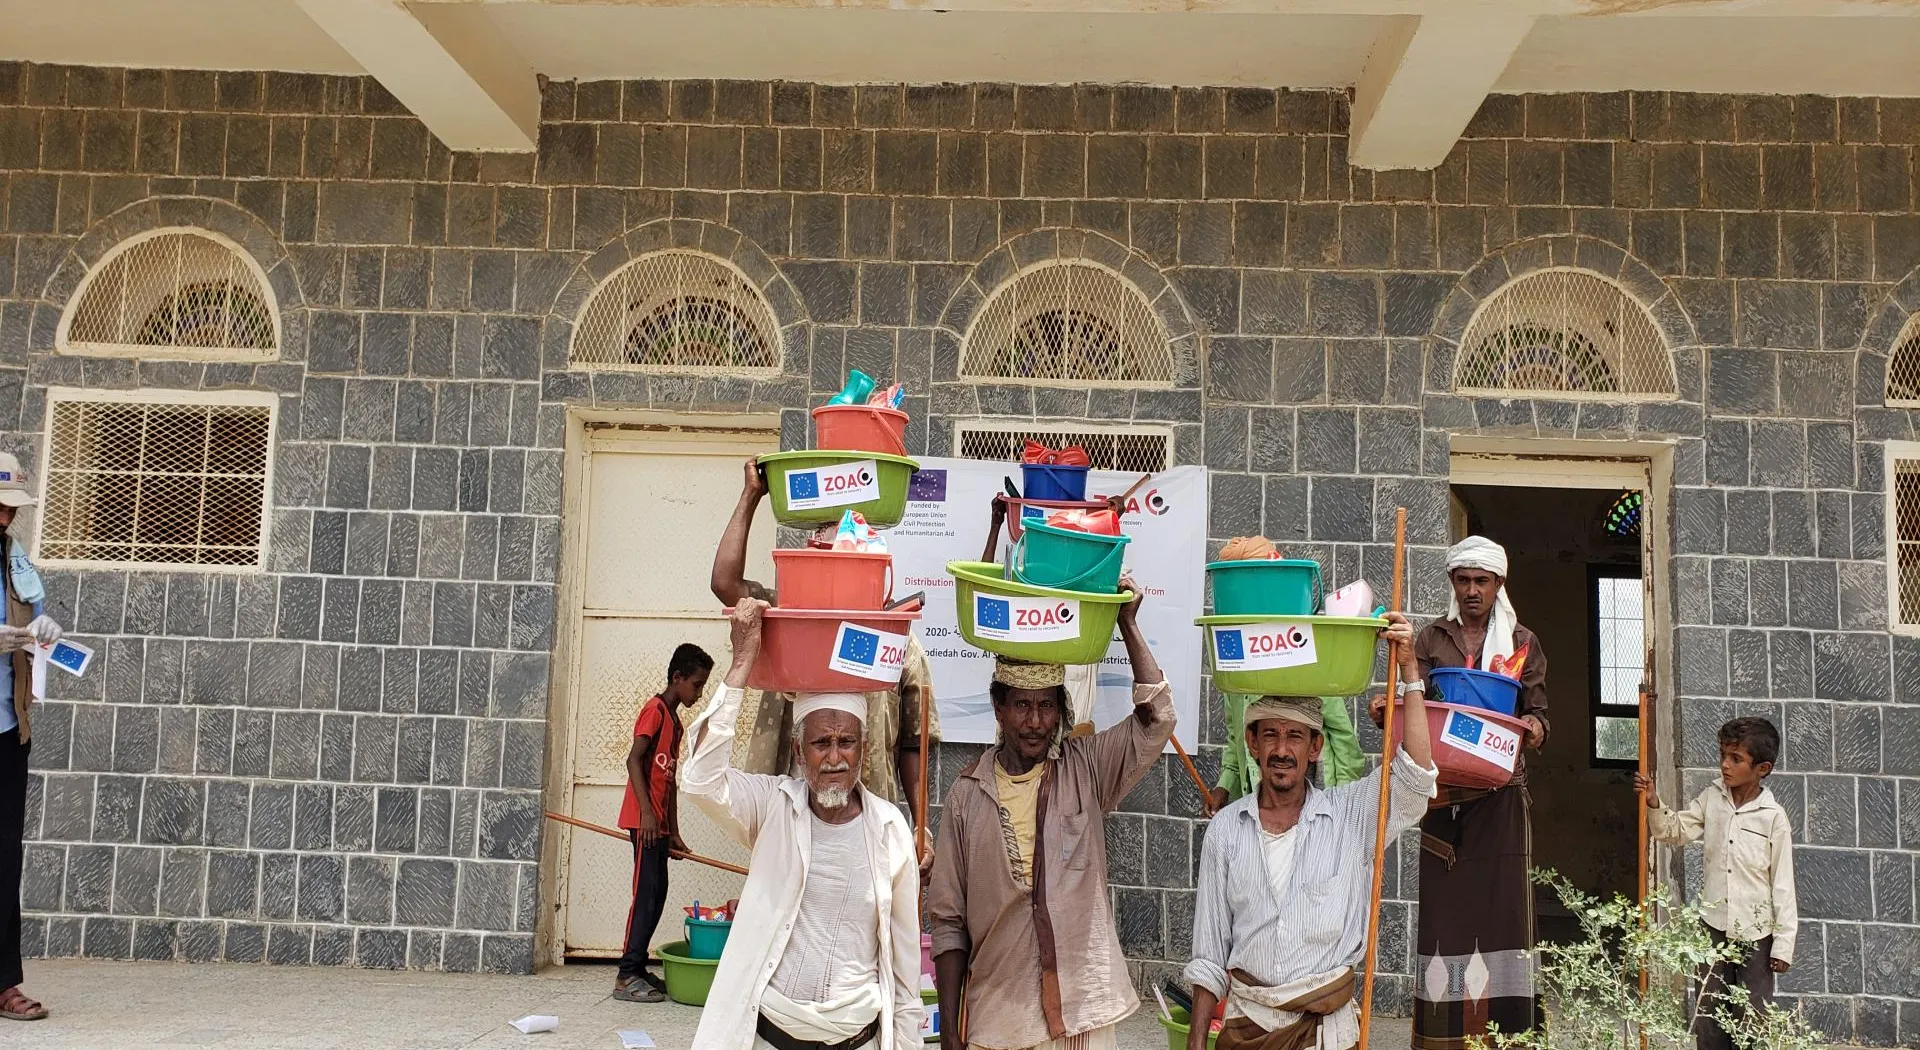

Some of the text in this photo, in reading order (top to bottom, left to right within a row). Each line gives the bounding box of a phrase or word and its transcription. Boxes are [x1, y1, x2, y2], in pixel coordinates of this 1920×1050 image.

[904, 577, 1165, 596] Distribution from
[960, 650, 980, 658] Gov.
